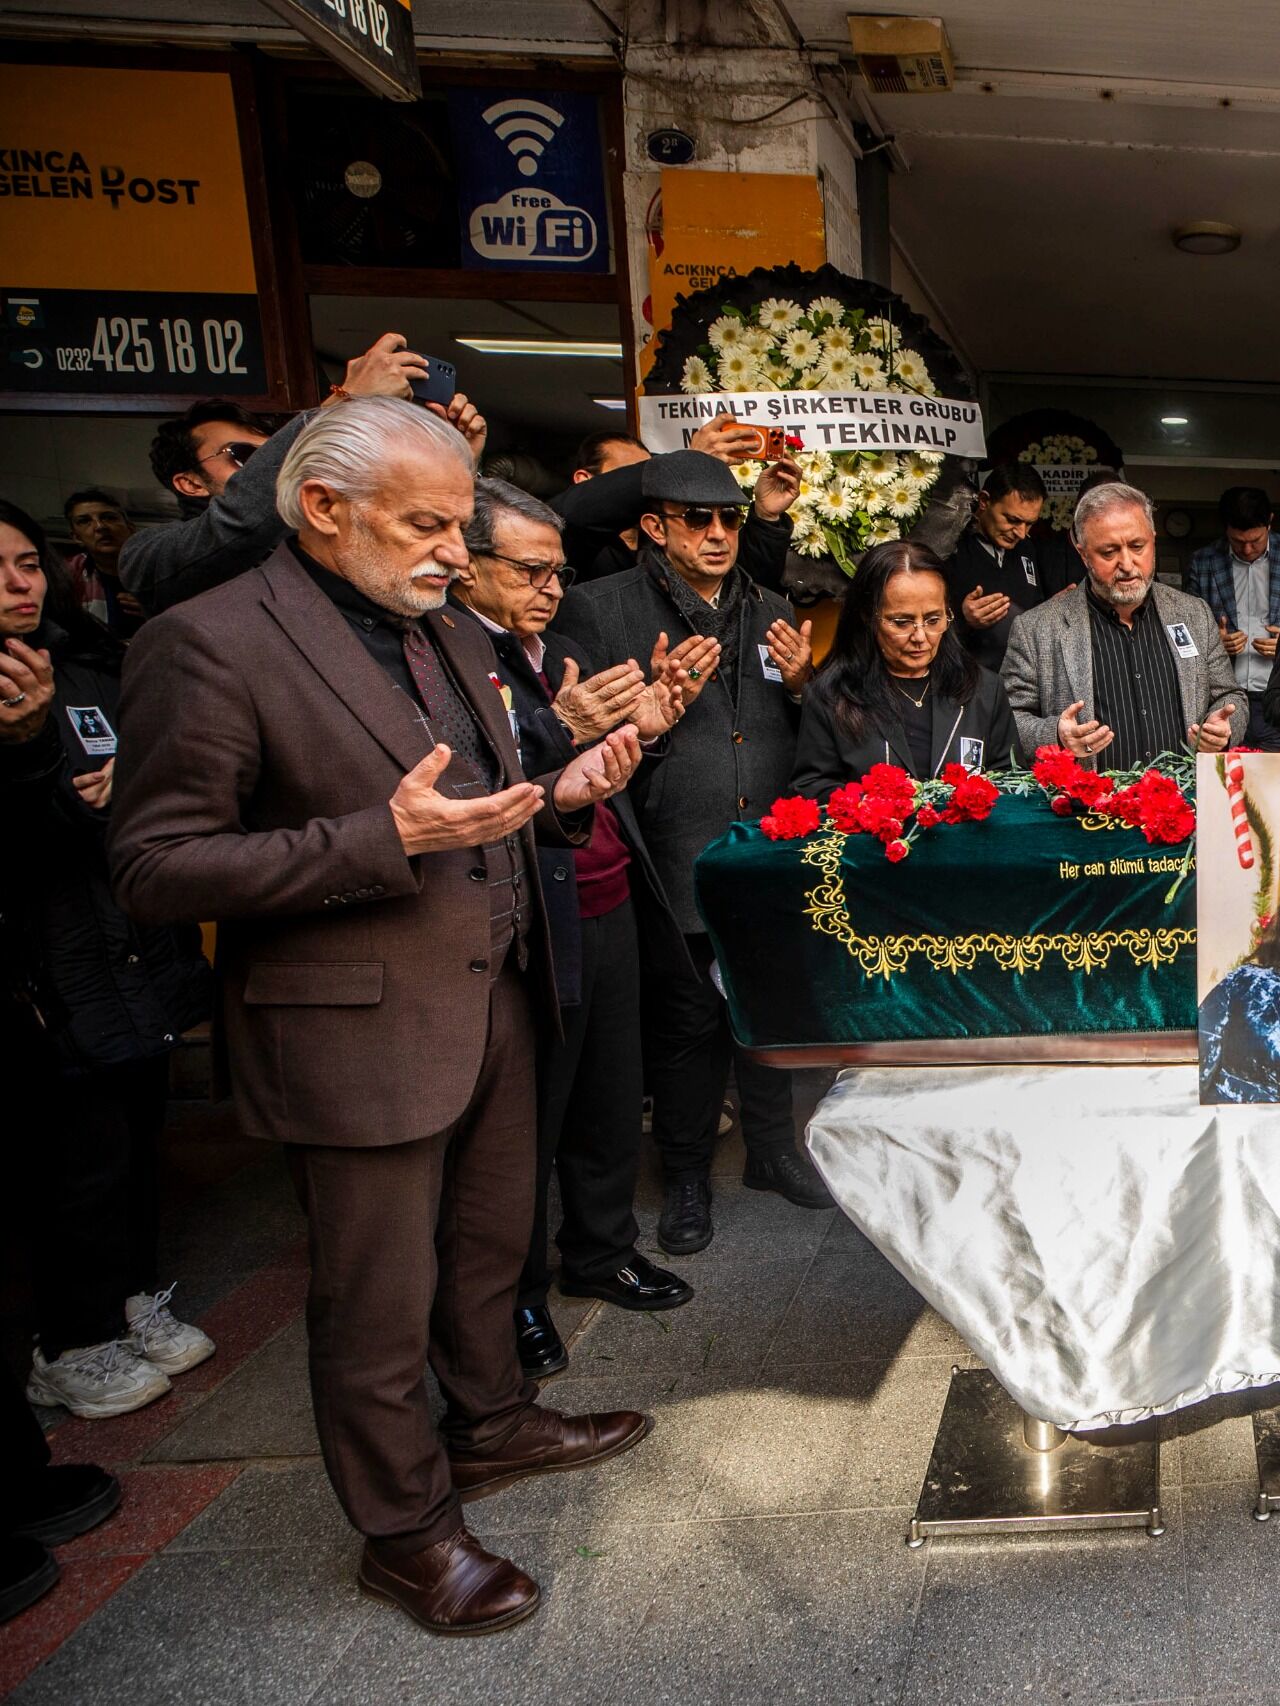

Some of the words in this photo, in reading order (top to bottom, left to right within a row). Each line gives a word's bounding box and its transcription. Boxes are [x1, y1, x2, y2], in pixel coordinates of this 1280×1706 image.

[511, 194, 552, 209] Free
[56, 347, 93, 372] 0232
[92, 317, 155, 373] 425
[160, 318, 197, 374] 18
[203, 319, 248, 374] 02
[658, 397, 758, 419] TEKİNALP
[767, 394, 904, 420] ŞİRKETLER
[909, 400, 977, 424] GRUBU
[816, 418, 957, 448] TEKİNALP
[1059, 861, 1080, 880] Her
[1084, 862, 1105, 876] can
[1109, 858, 1145, 876] ölümü
